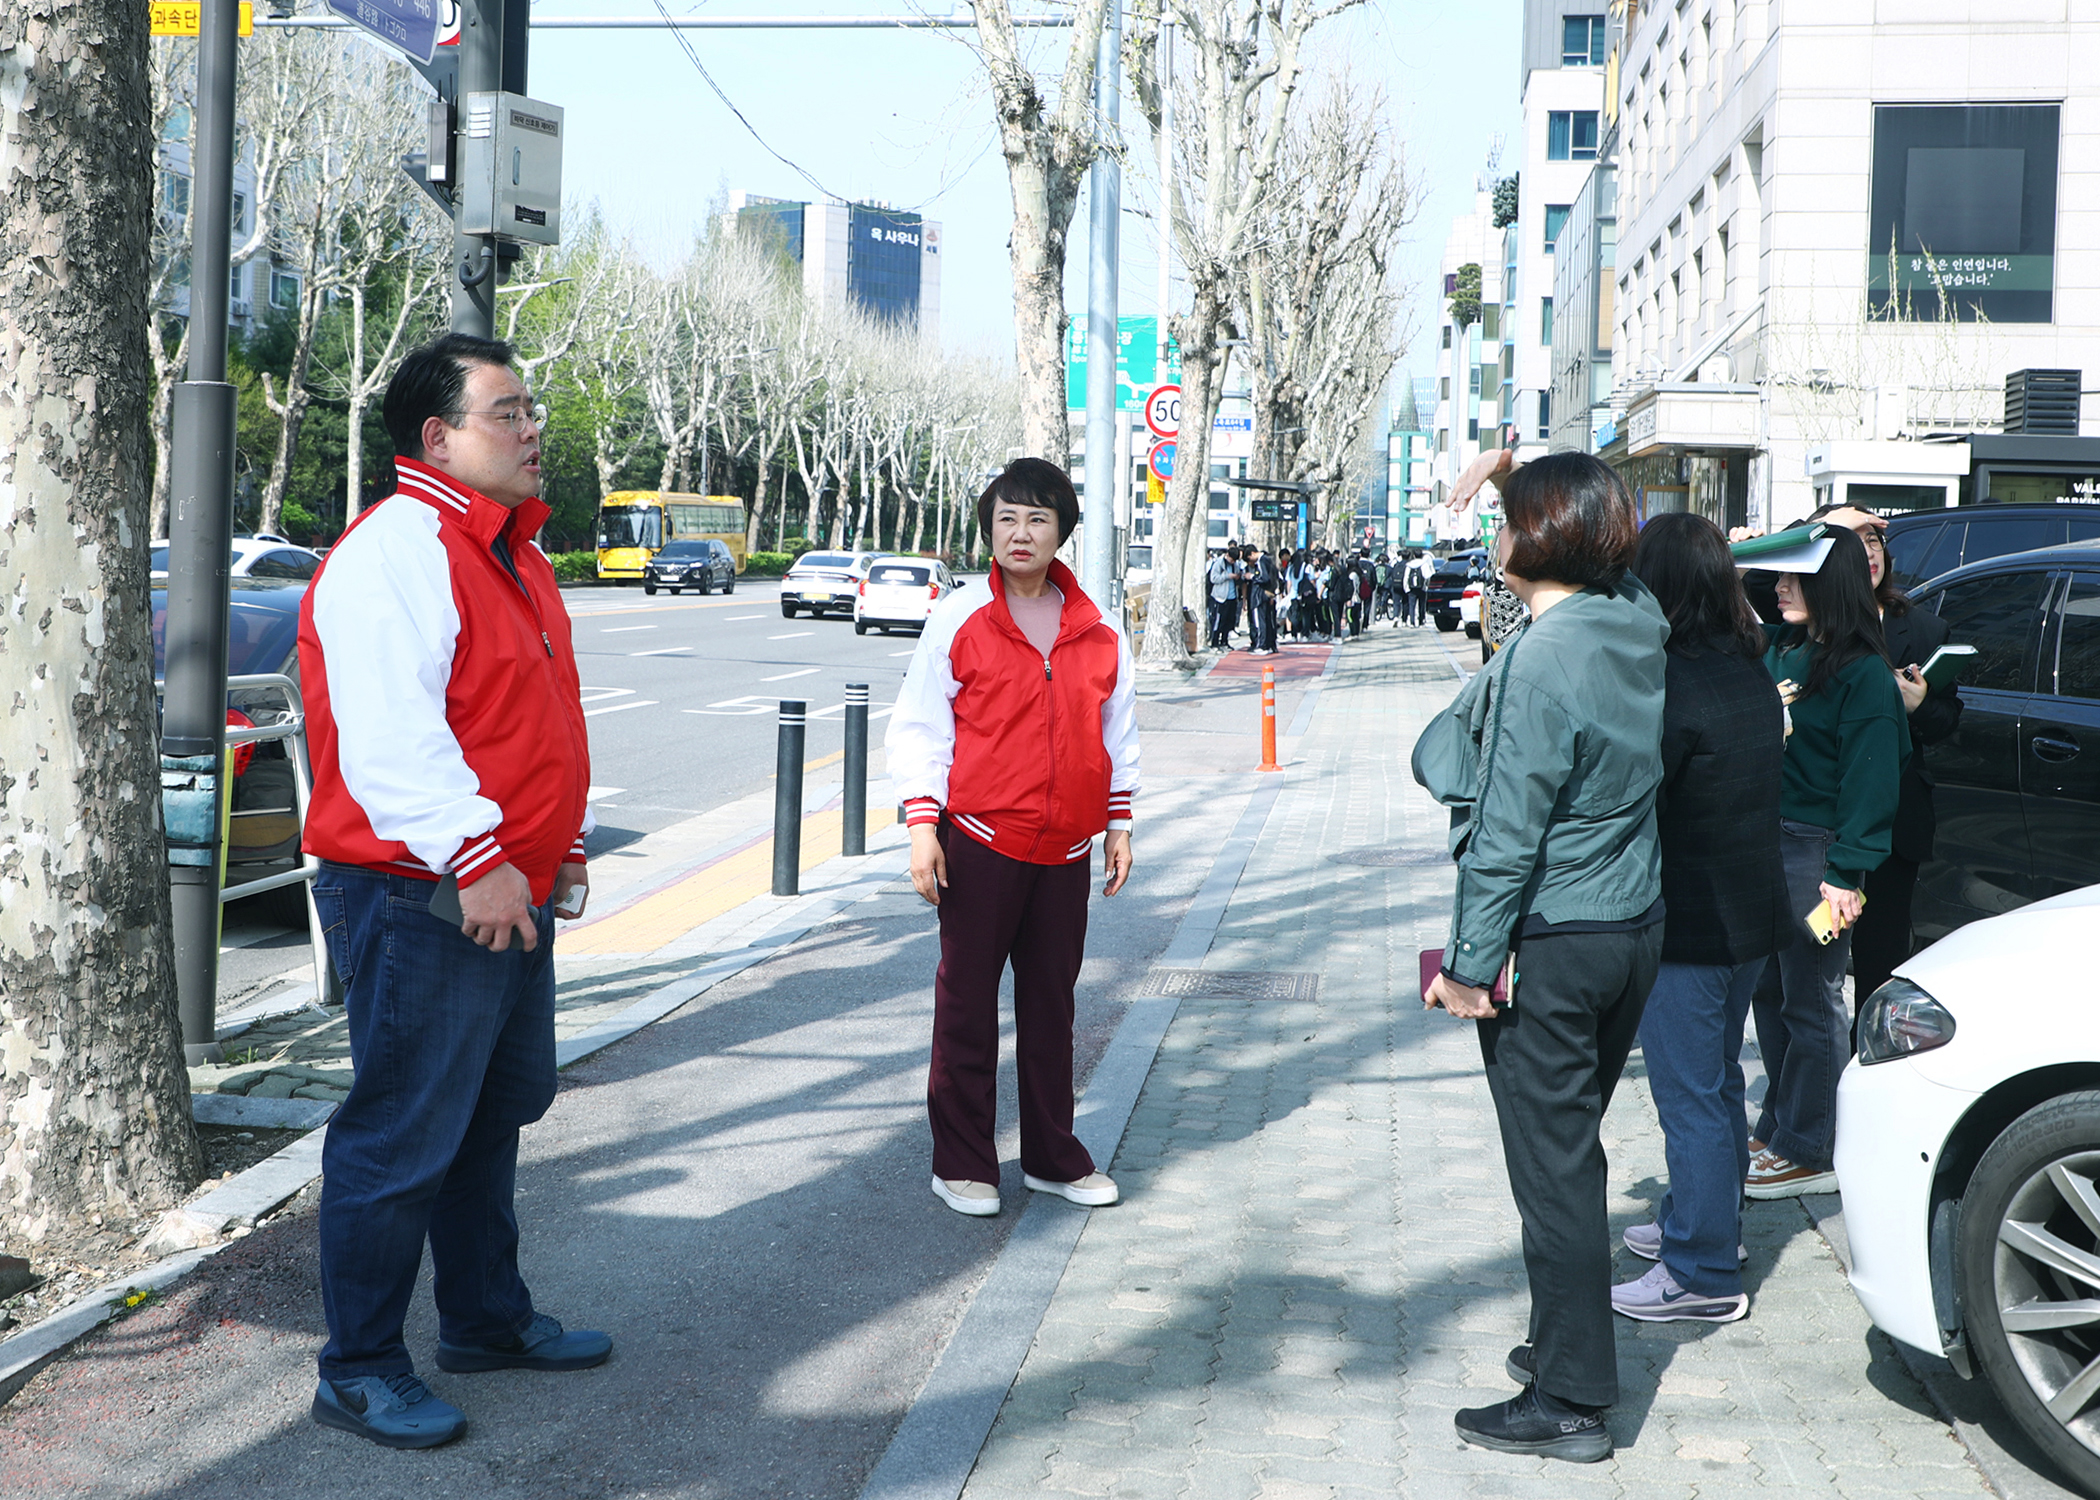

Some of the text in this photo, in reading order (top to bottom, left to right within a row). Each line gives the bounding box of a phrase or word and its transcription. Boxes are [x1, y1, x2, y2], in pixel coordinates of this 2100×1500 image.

[154, 8, 199, 29] 과속단
[885, 230, 919, 247] 사우나
[1911, 258, 1923, 271] 참
[1952, 258, 2012, 271] 인연입니다.
[1155, 400, 1181, 422] 50
[1866, 507, 1891, 517] ALET
